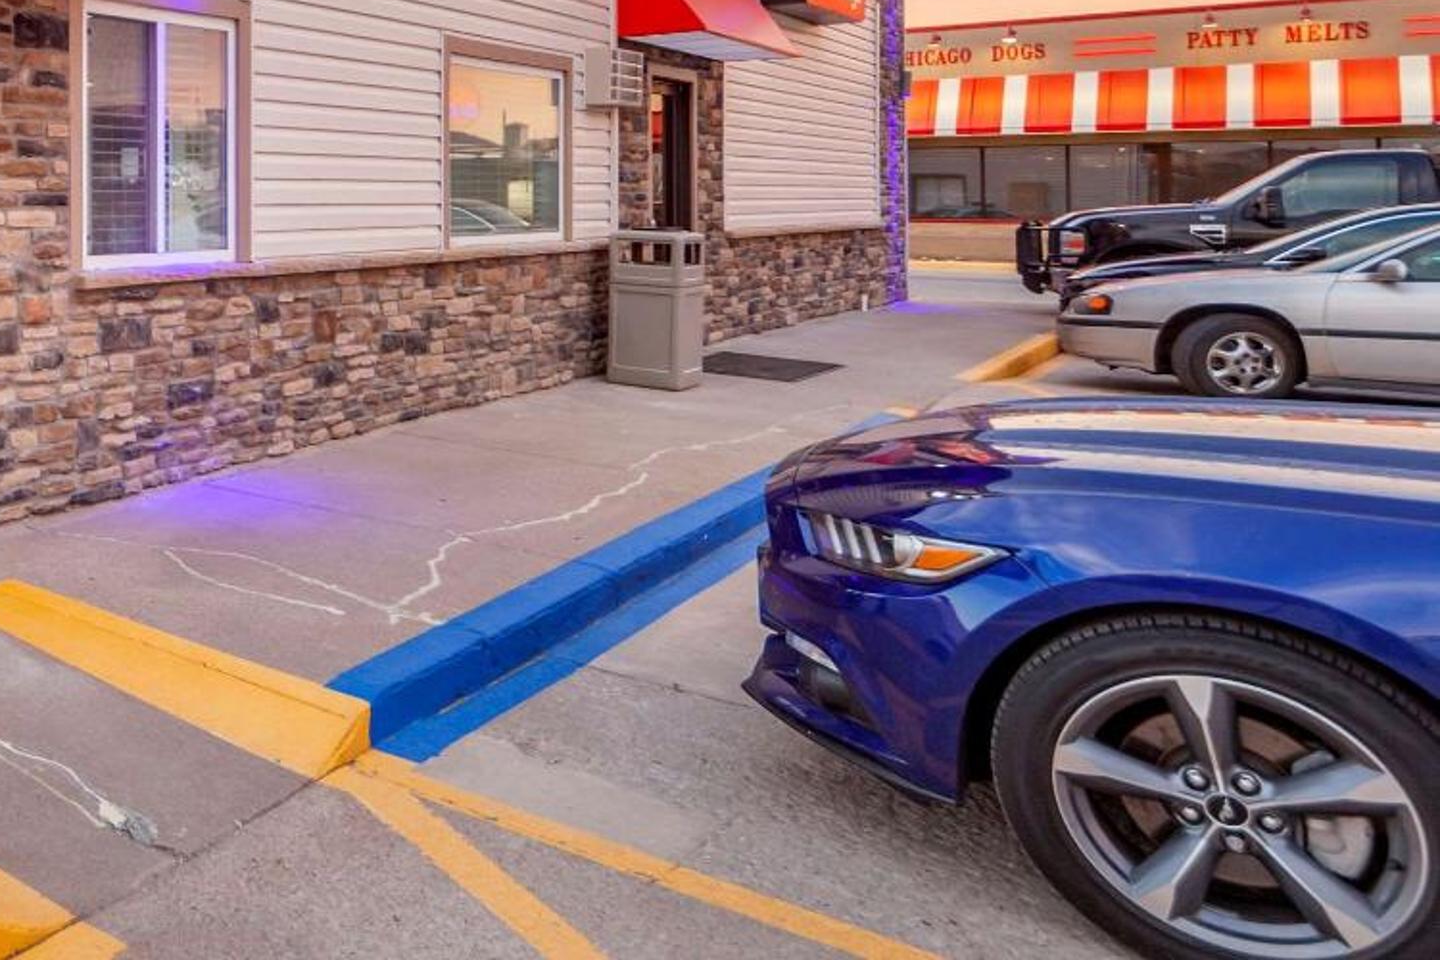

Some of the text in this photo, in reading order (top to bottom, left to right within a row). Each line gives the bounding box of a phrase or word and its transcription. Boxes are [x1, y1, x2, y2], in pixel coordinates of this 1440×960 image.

[1187, 21, 1370, 49] PATTY MELTS
[905, 43, 1046, 66] HICAGO DOGS
